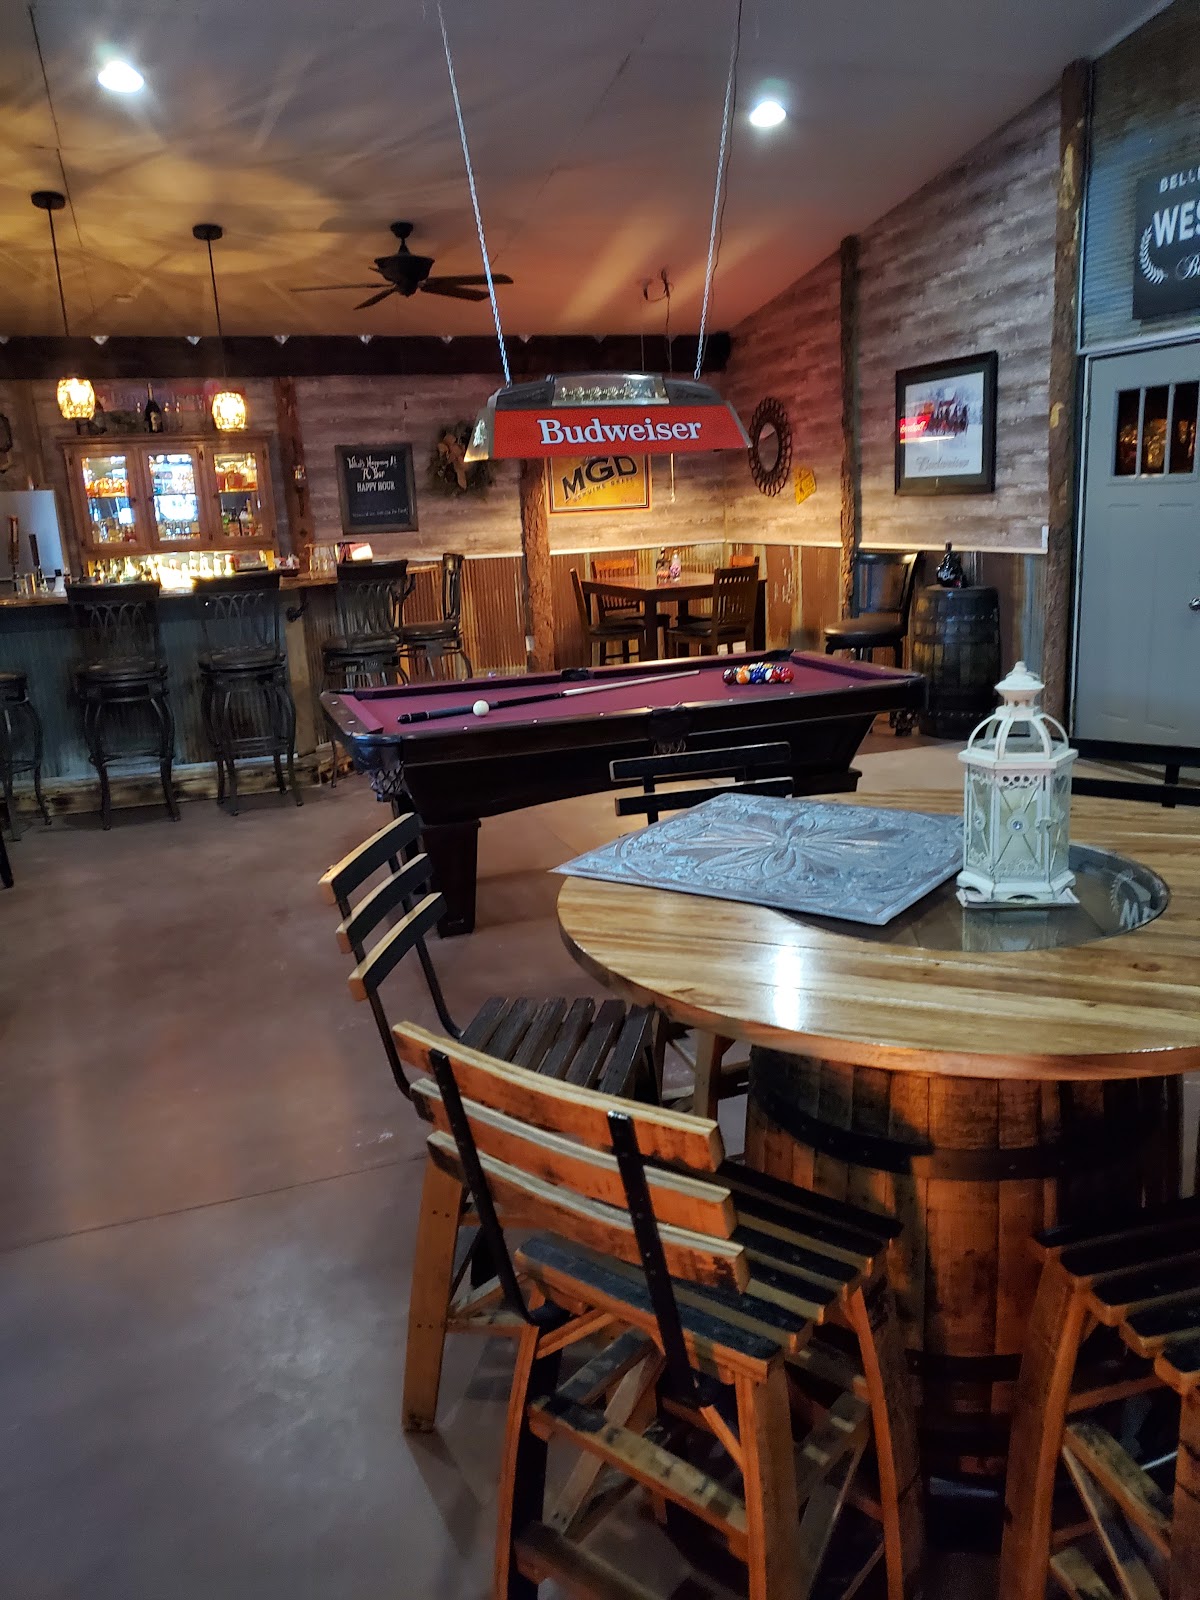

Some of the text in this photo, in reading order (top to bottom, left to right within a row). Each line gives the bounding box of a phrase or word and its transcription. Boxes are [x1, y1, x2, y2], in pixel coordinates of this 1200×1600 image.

[1159, 166, 1200, 193] BELL
[537, 418, 701, 444] Budweiser
[357, 481, 396, 492] HAPPY HOUR
[561, 455, 638, 500] MGD
